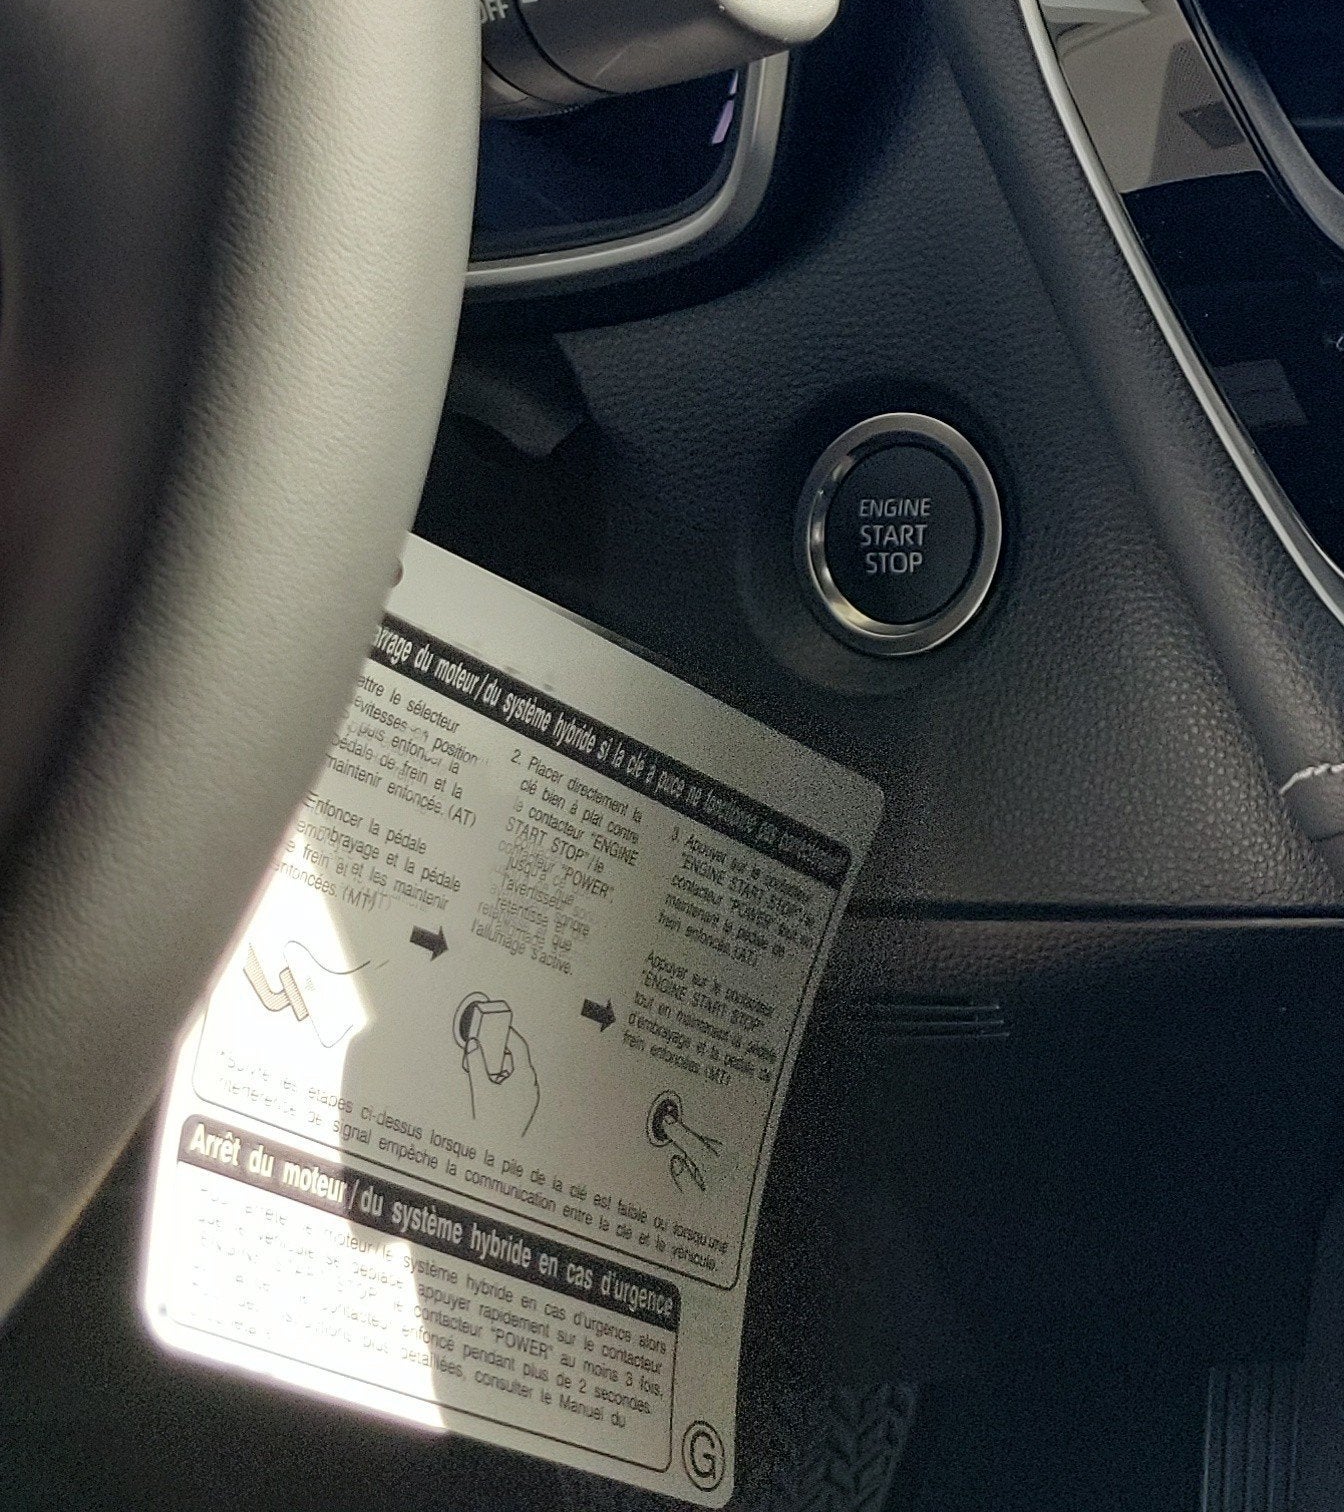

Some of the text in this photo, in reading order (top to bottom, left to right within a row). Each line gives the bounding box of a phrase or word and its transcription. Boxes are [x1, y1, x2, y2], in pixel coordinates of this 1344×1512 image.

[859, 498, 932, 519] ENGINE
[860, 524, 929, 548] START
[865, 551, 924, 575] STOP
[389, 687, 461, 735] le sélecteur
[413, 638, 435, 674] du
[500, 683, 553, 740] système
[551, 709, 598, 761] hybride
[597, 733, 613, 762] si
[432, 732, 478, 771] position
[433, 775, 446, 793] et
[451, 781, 463, 800] la
[510, 746, 629, 816] 2. Placer directement
[519, 775, 538, 796] clé
[447, 801, 477, 830] (AT)
[505, 815, 547, 847] START
[528, 803, 585, 842] contacteur
[367, 816, 427, 859] la pédale
[385, 849, 461, 896] et la pédale
[392, 875, 449, 913] maintenir
[359, 1103, 424, 1141] ci-dessus
[428, 1128, 477, 1164] lorsque
[482, 1149, 496, 1168] la
[500, 1156, 525, 1180] pile
[529, 1166, 547, 1186] de
[331, 1116, 372, 1148] signal
[377, 1132, 439, 1171] empêche
[444, 1158, 458, 1176] la
[464, 1166, 558, 1213] communication
[561, 1203, 594, 1226] entre
[188, 1118, 243, 1167] Arrêt
[246, 1141, 276, 1178] du
[387, 1191, 466, 1252] système
[466, 1222, 534, 1275] hybride
[536, 1252, 561, 1278] en
[564, 1261, 595, 1290] cas
[401, 1251, 459, 1287] système
[464, 1273, 514, 1306] hybride
[520, 1294, 538, 1311] en
[543, 1302, 567, 1321] cas
[412, 1302, 483, 1338] contacteur
[559, 1352, 576, 1368] au
[414, 1281, 471, 1314] appuyer
[477, 1300, 551, 1339] rapidement
[555, 1329, 576, 1346] sur
[582, 1336, 595, 1352] le
[473, 1367, 534, 1399] consulter
[690, 1430, 716, 1480] G
